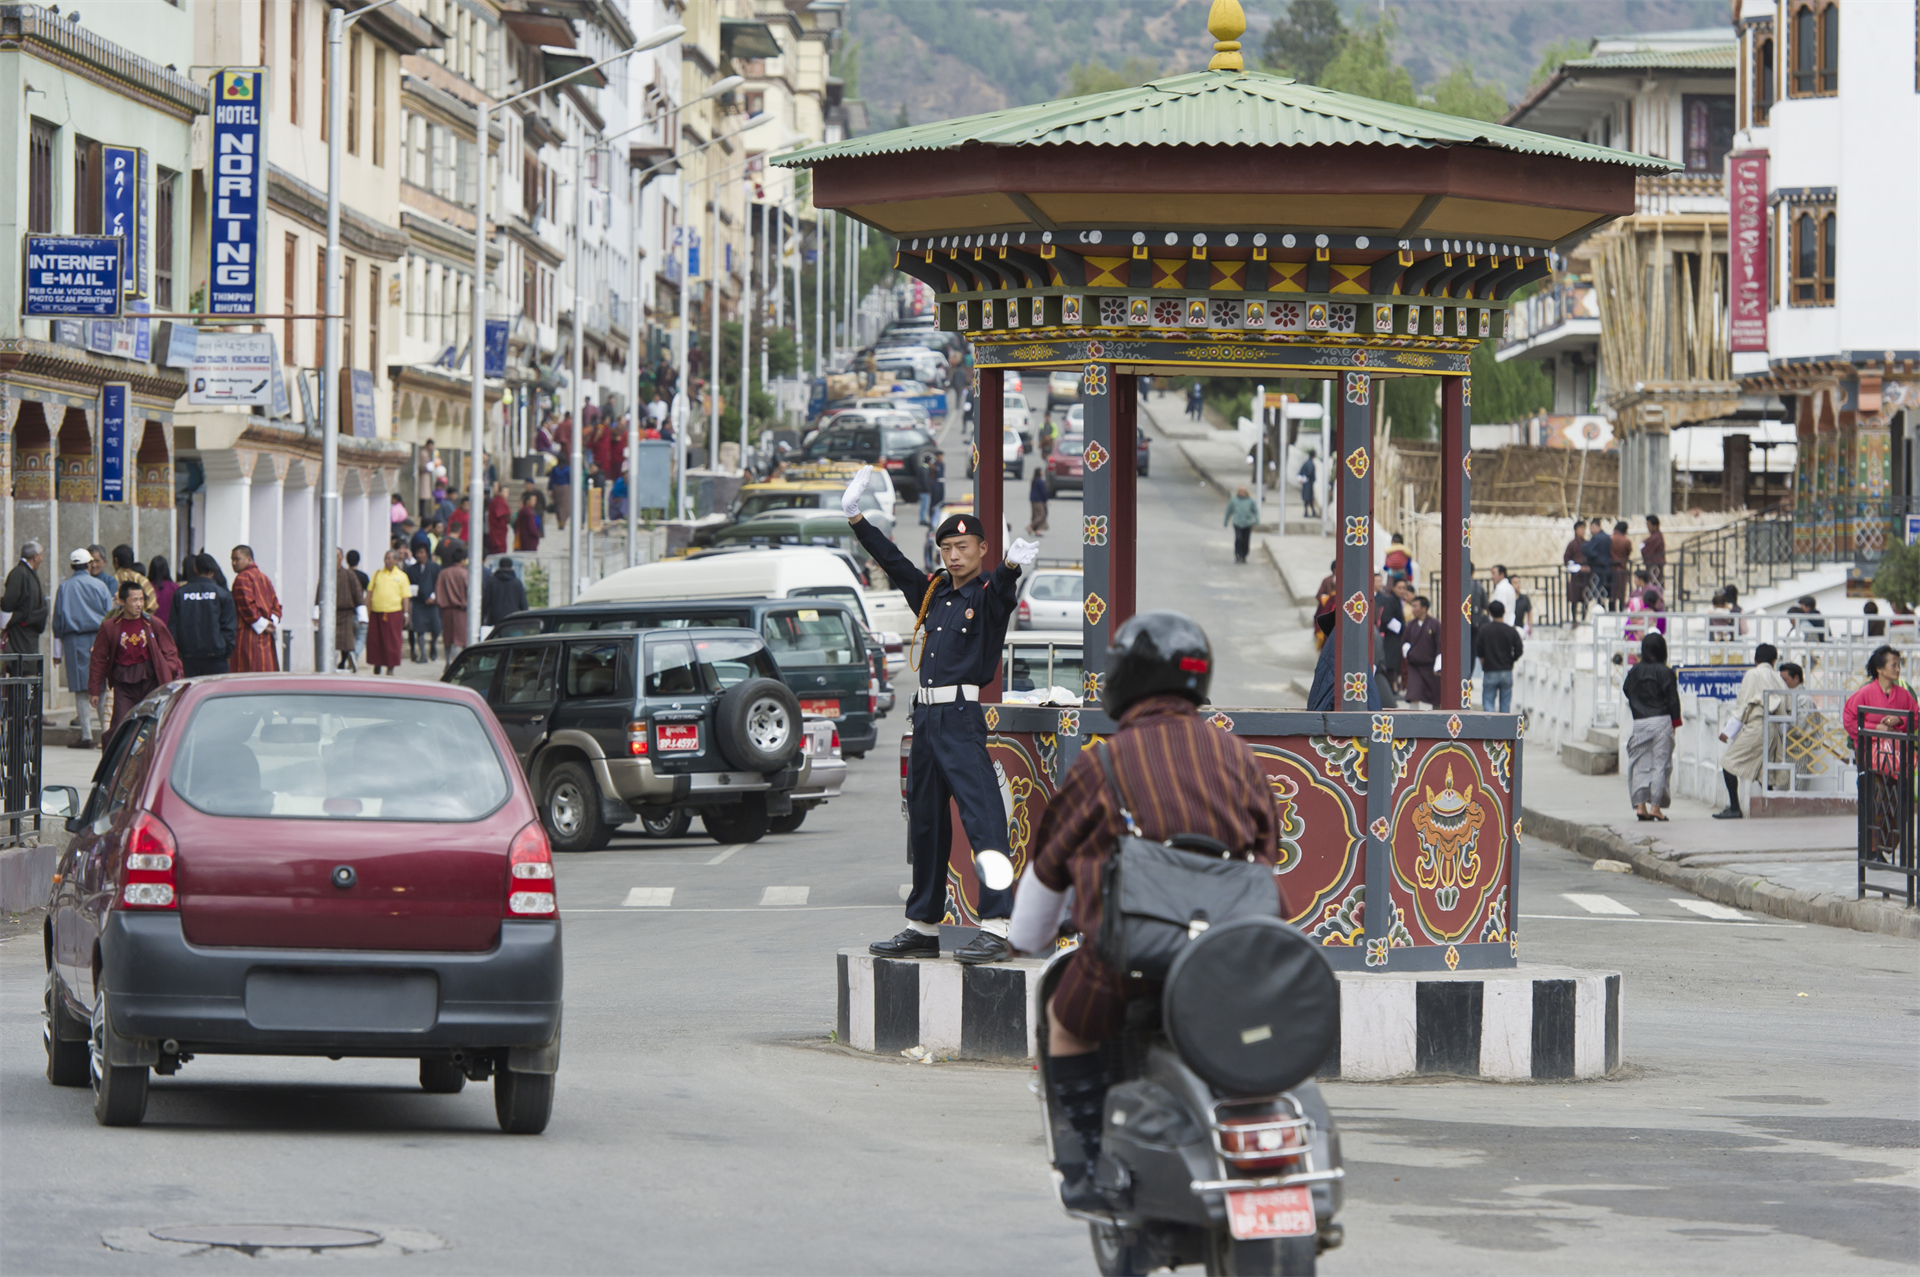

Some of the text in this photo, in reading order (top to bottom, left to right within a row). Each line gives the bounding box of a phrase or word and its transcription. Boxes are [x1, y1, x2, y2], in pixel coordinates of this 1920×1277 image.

[216, 105, 259, 125] HOTEL
[216, 133, 253, 286] NORLING
[29, 254, 117, 271] INTERNET
[41, 272, 104, 286] E-MAIL
[28, 287, 45, 295] WEB
[66, 288, 92, 296] VOICE
[94, 288, 117, 296] CHAT
[28, 295, 54, 303] PHOTO
[212, 292, 253, 303] THIMPHU
[214, 303, 250, 313] BHUTAN
[183, 591, 217, 600] POLICE
